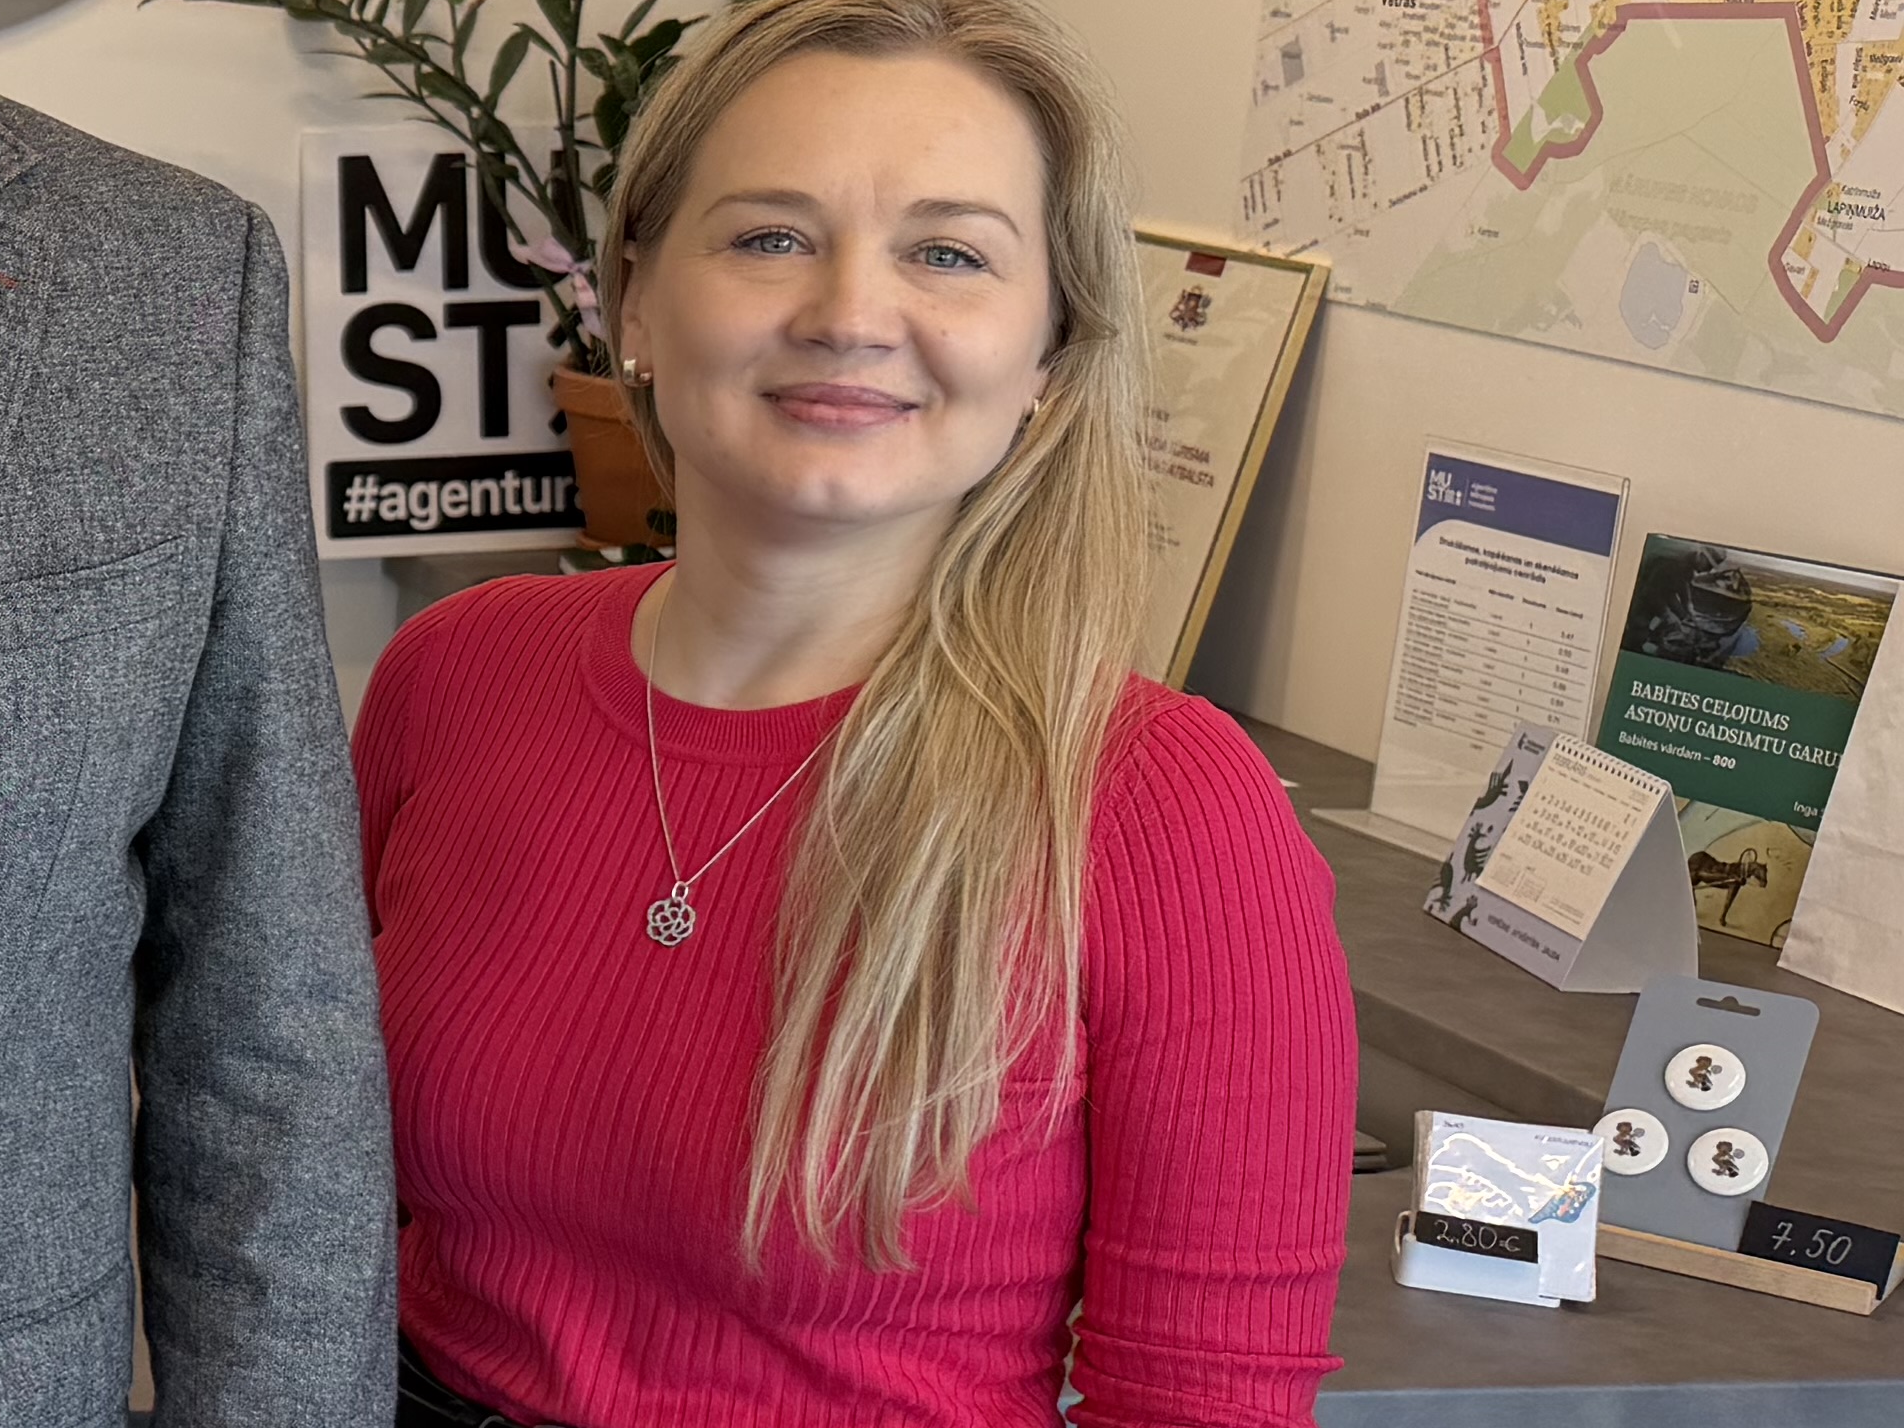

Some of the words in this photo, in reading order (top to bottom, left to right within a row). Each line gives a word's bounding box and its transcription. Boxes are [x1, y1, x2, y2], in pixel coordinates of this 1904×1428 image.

[343, 470, 583, 530] #agentur
[1624, 704, 1692, 733] ASTOŅU
[1695, 720, 1787, 755] GADSIMTU
[1789, 742, 1843, 768] GARU
[1702, 697, 1790, 731] CEĻOJUMS
[1712, 754, 1737, 770] 800
